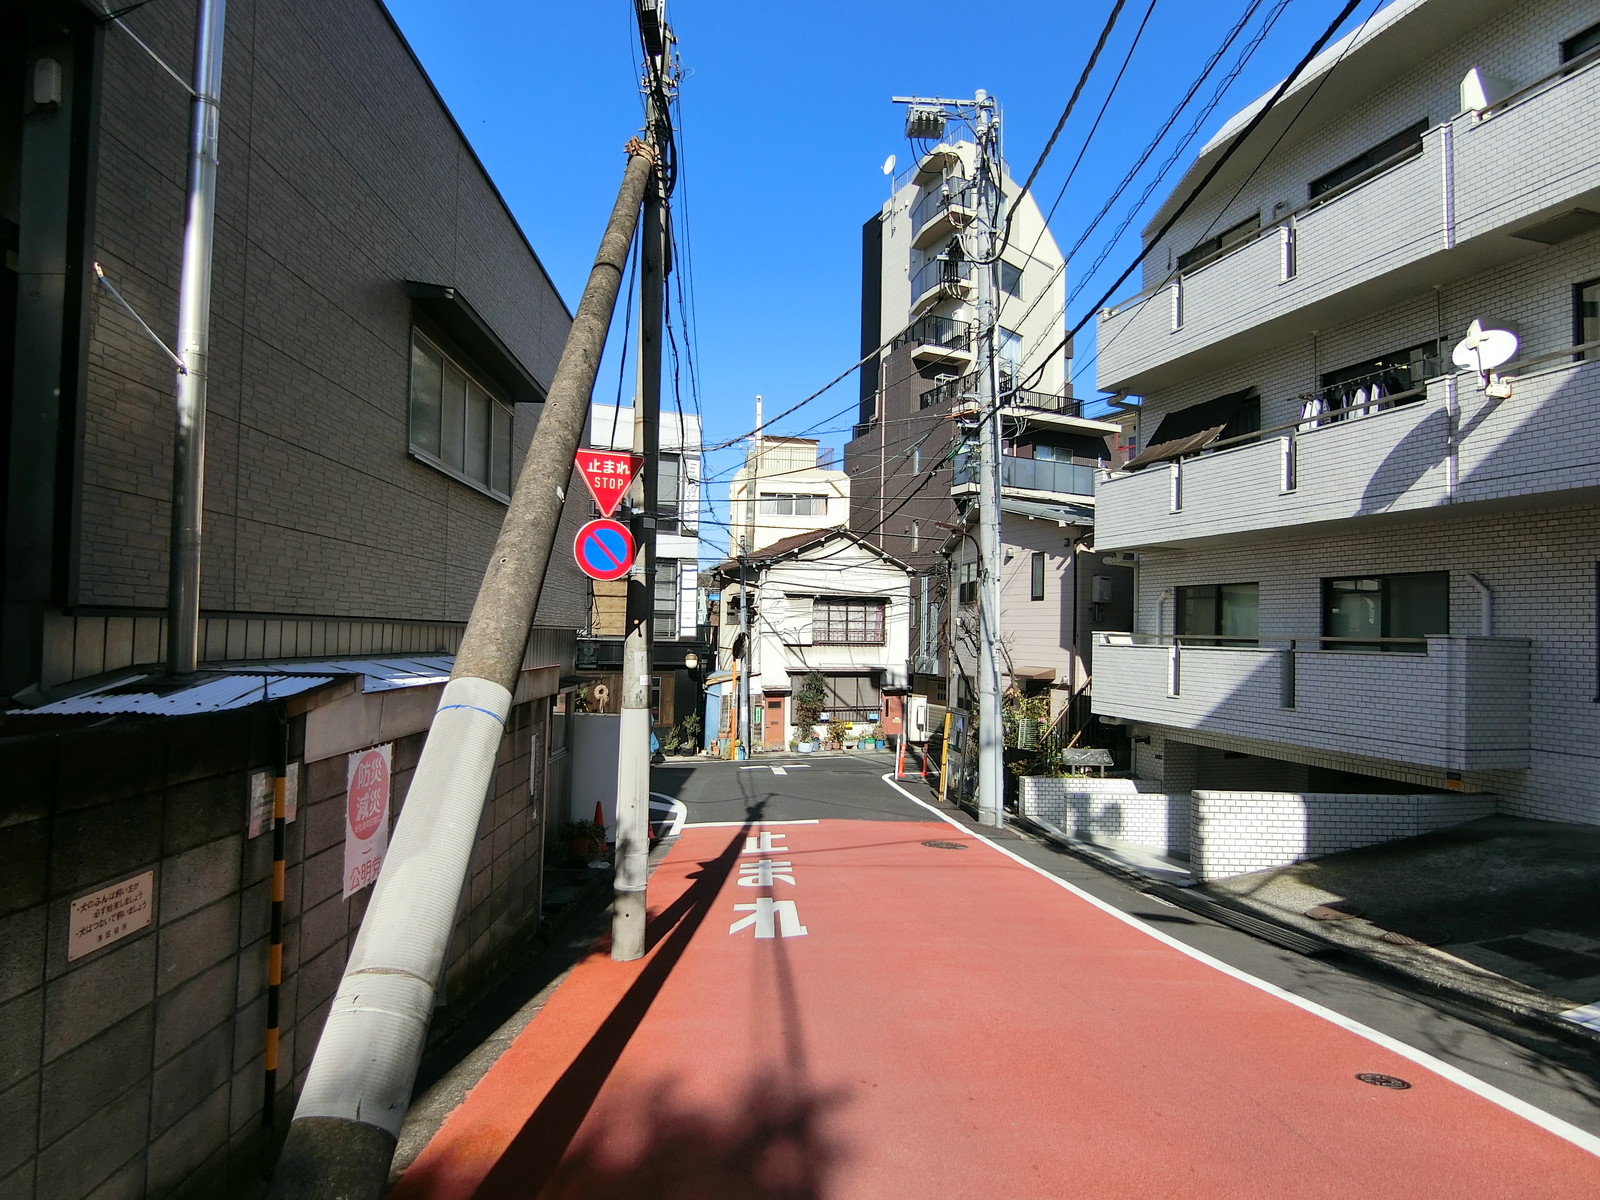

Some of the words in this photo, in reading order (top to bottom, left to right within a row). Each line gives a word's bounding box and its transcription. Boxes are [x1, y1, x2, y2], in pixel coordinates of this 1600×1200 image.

[587, 458, 630, 475] 止まれ
[594, 476, 624, 490] STOP
[357, 757, 382, 790] 防災
[356, 788, 381, 821] 減災
[349, 855, 382, 891] 公明党
[728, 831, 808, 939] 止まれ
